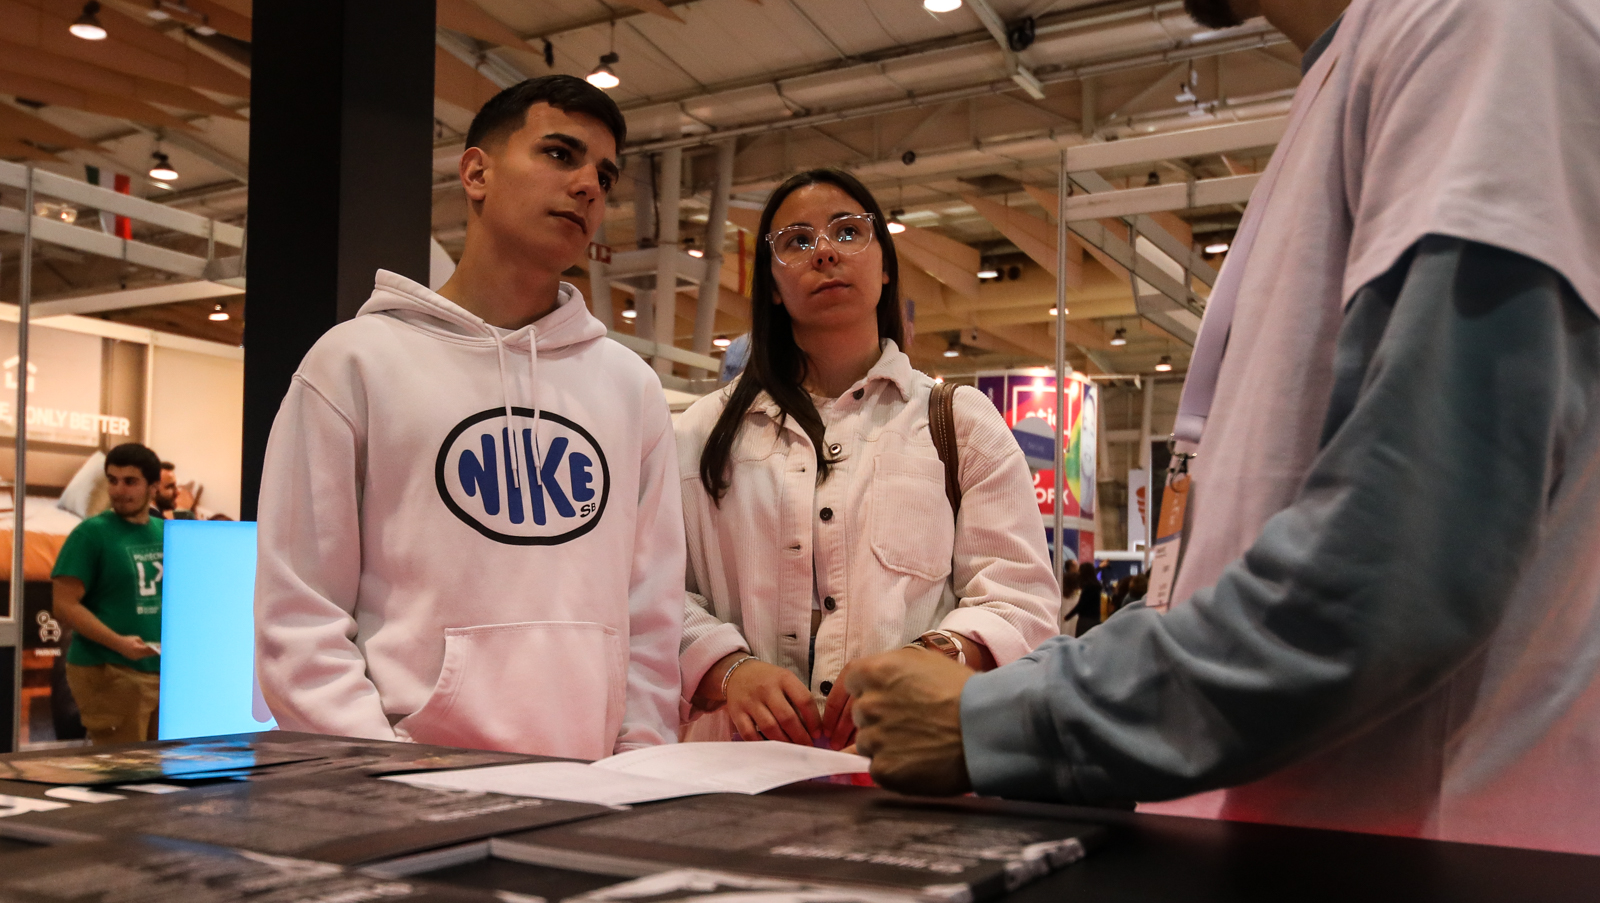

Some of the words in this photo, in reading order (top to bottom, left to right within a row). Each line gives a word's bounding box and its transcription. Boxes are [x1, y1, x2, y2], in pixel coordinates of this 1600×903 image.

[26, 406, 67, 428] ONLY
[69, 411, 130, 437] BETTER
[458, 427, 595, 526] NIKE
[580, 503, 597, 518] SB
